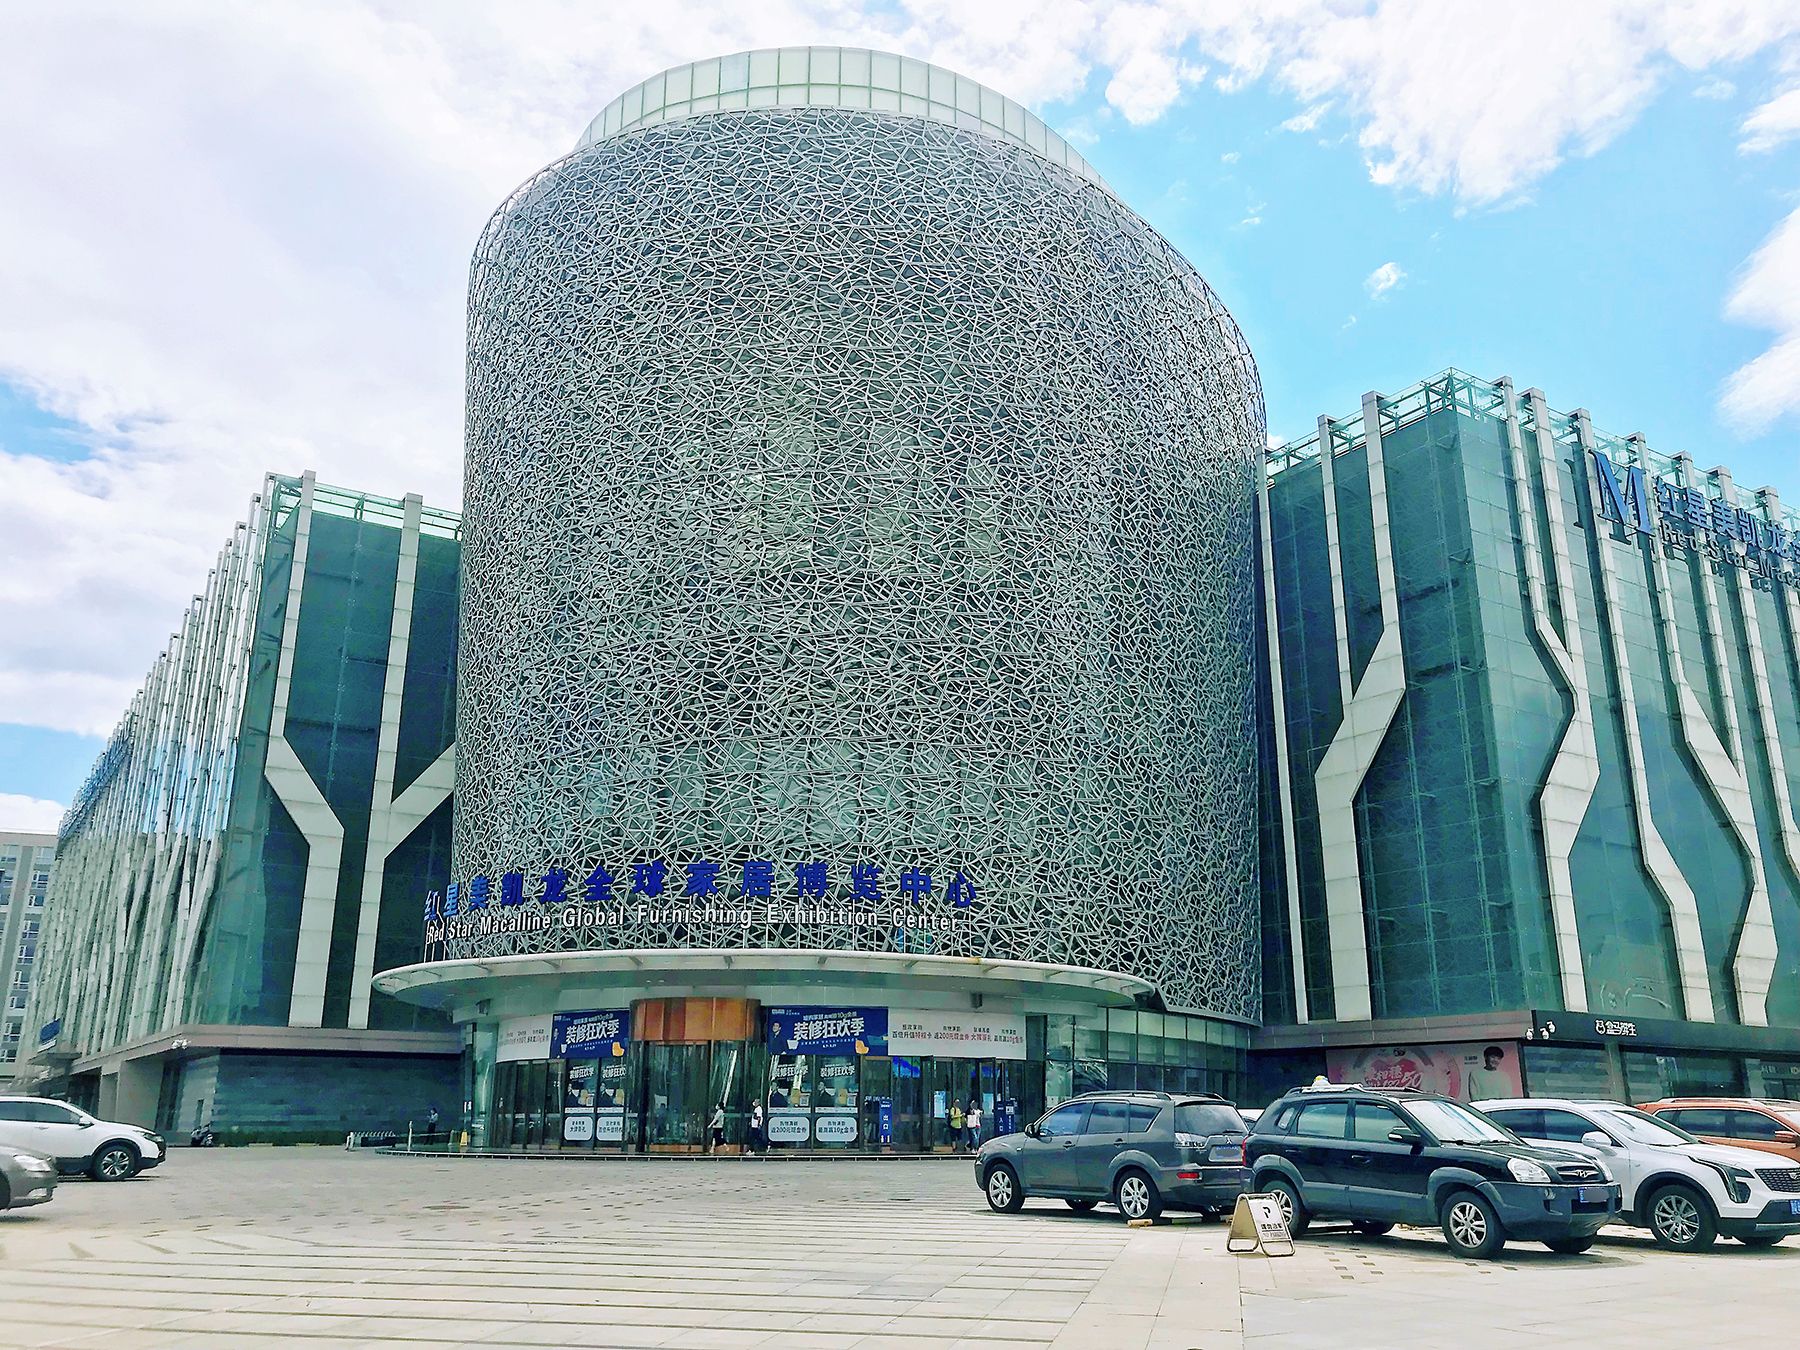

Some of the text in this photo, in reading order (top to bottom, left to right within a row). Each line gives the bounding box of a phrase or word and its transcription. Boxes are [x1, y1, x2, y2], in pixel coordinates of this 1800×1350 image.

[424, 860, 977, 921] 红星美凯龙全球家居博览中心
[427, 902, 958, 944] Red Star Macalline Global Furnishing Exhibition Center
[567, 1019, 619, 1044] 装修狂欢季
[794, 1017, 865, 1040] 装修狂欢季
